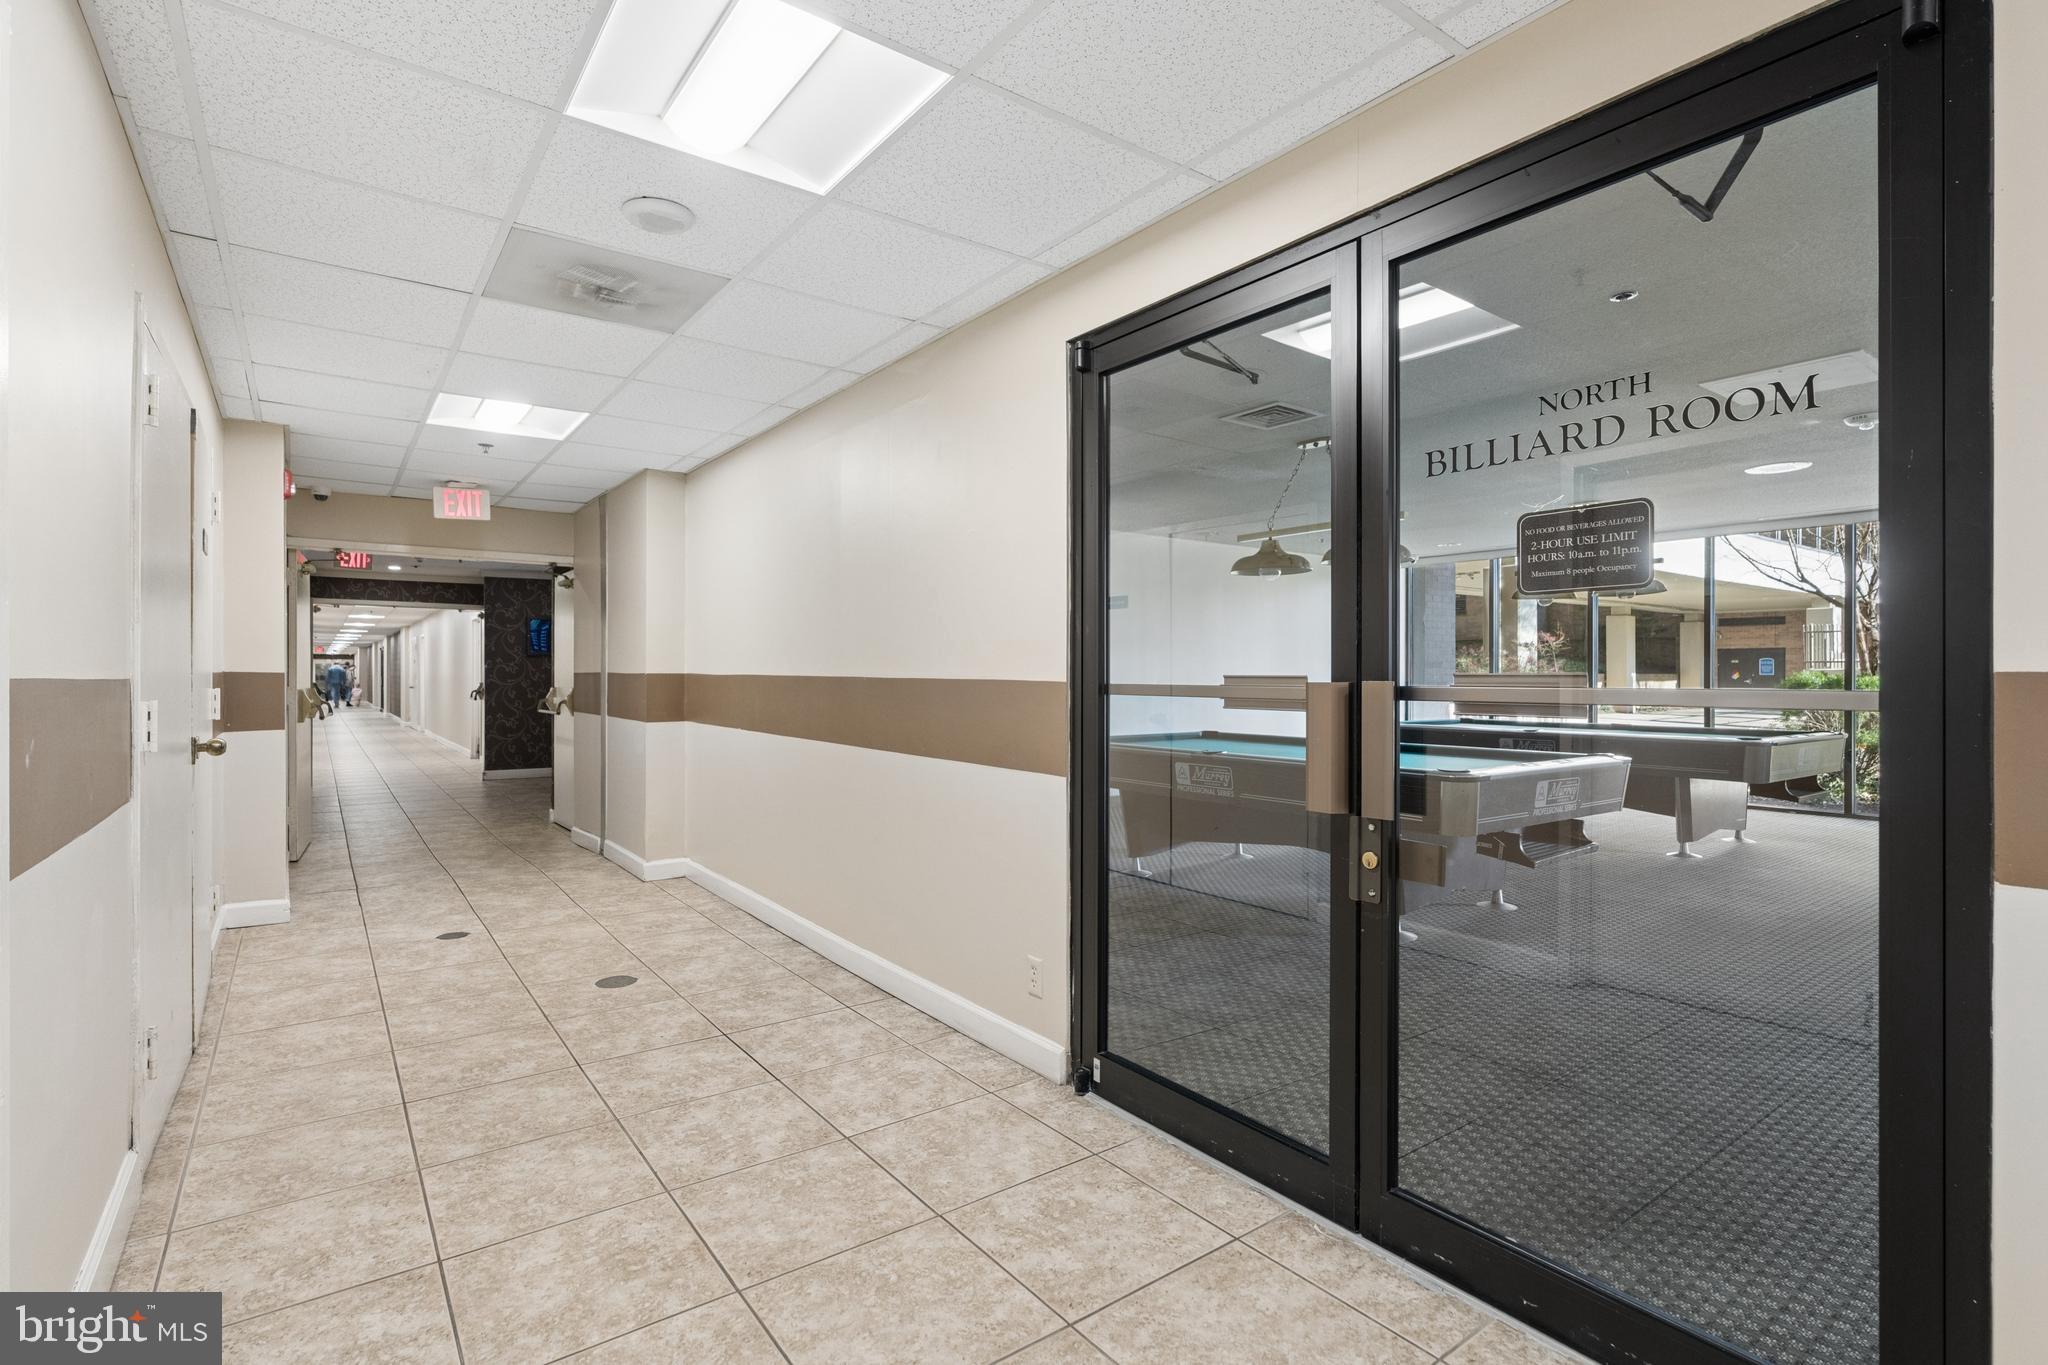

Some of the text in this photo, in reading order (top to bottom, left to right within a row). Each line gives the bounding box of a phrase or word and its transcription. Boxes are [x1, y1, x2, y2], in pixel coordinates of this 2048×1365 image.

[1538, 371, 1653, 416] NORTH
[1425, 373, 1820, 479] BILLIARD ROOM
[443, 489, 484, 517] EXIT
[1536, 527, 1555, 535] FOOD
[1566, 520, 1607, 531] BEVERAGES
[1608, 515, 1645, 526] ALLOWED
[1531, 530, 1638, 550] 2-HOUR USE LIMIT
[340, 552, 367, 568] EXIT
[1527, 551, 1565, 563] HOURS:
[1568, 550, 1596, 559] 10a.m.
[1612, 546, 1642, 557] 11p.m.
[1531, 568, 1565, 578] Maximum
[1572, 566, 1595, 576] people
[1596, 564, 1637, 573] Occupancy
[1192, 766, 1230, 786] Murrey
